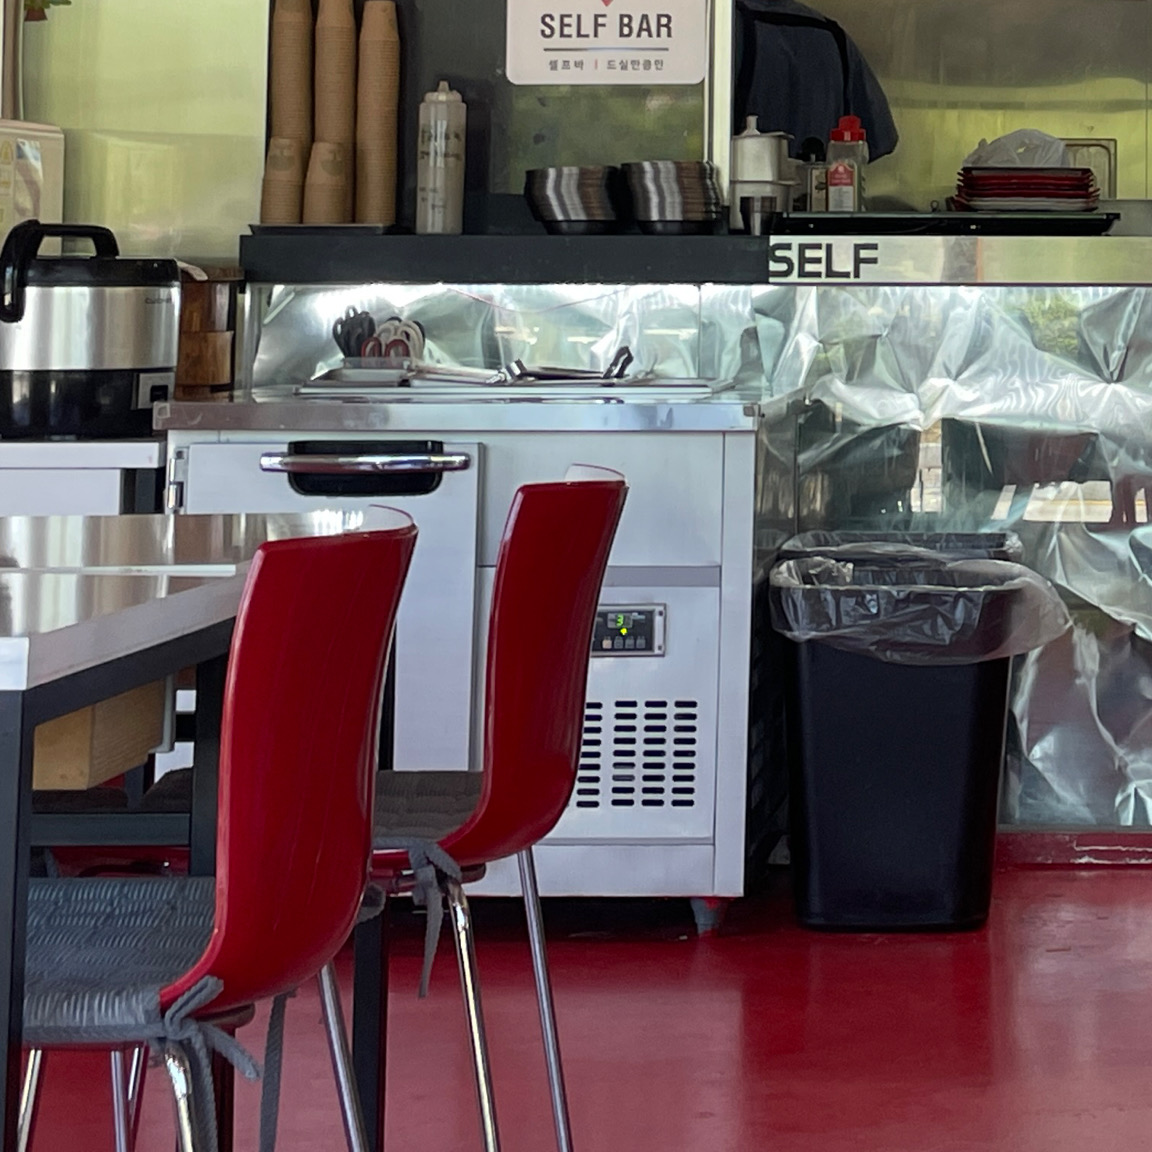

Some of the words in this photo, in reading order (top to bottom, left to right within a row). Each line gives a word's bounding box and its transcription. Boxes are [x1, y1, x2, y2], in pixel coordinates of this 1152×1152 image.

[540, 14, 608, 39] SELF
[618, 14, 673, 38] BAR
[549, 59, 584, 71] 셀프바
[769, 242, 879, 279] SELF
